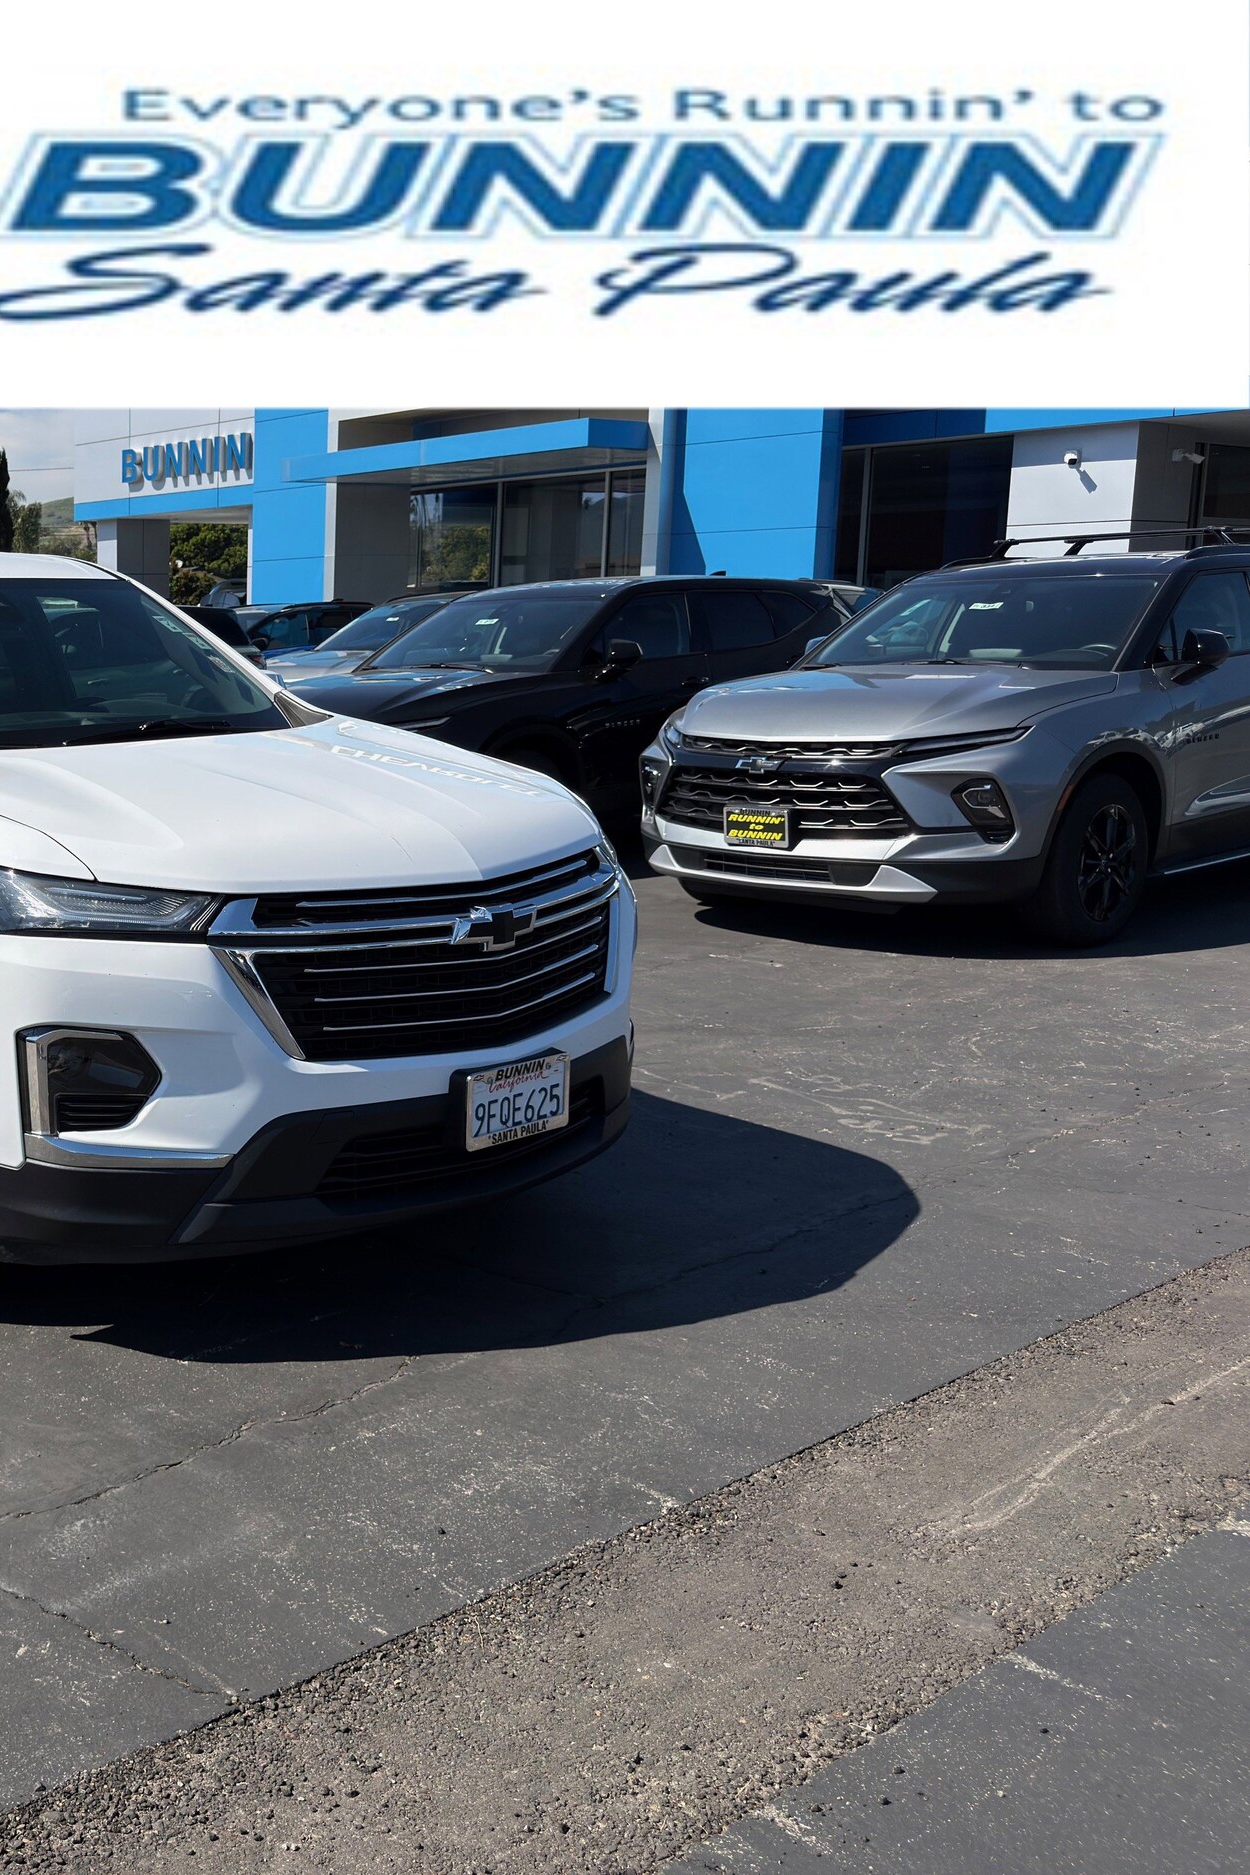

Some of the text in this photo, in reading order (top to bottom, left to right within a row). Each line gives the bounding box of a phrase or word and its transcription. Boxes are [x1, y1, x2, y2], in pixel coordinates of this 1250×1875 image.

[121, 432, 253, 483] BUNNIN
[728, 829, 783, 841] BUNNIN
[488, 1070, 549, 1093] California
[495, 1059, 546, 1081] BUNNIN
[474, 1083, 561, 1138] 9FQE625
